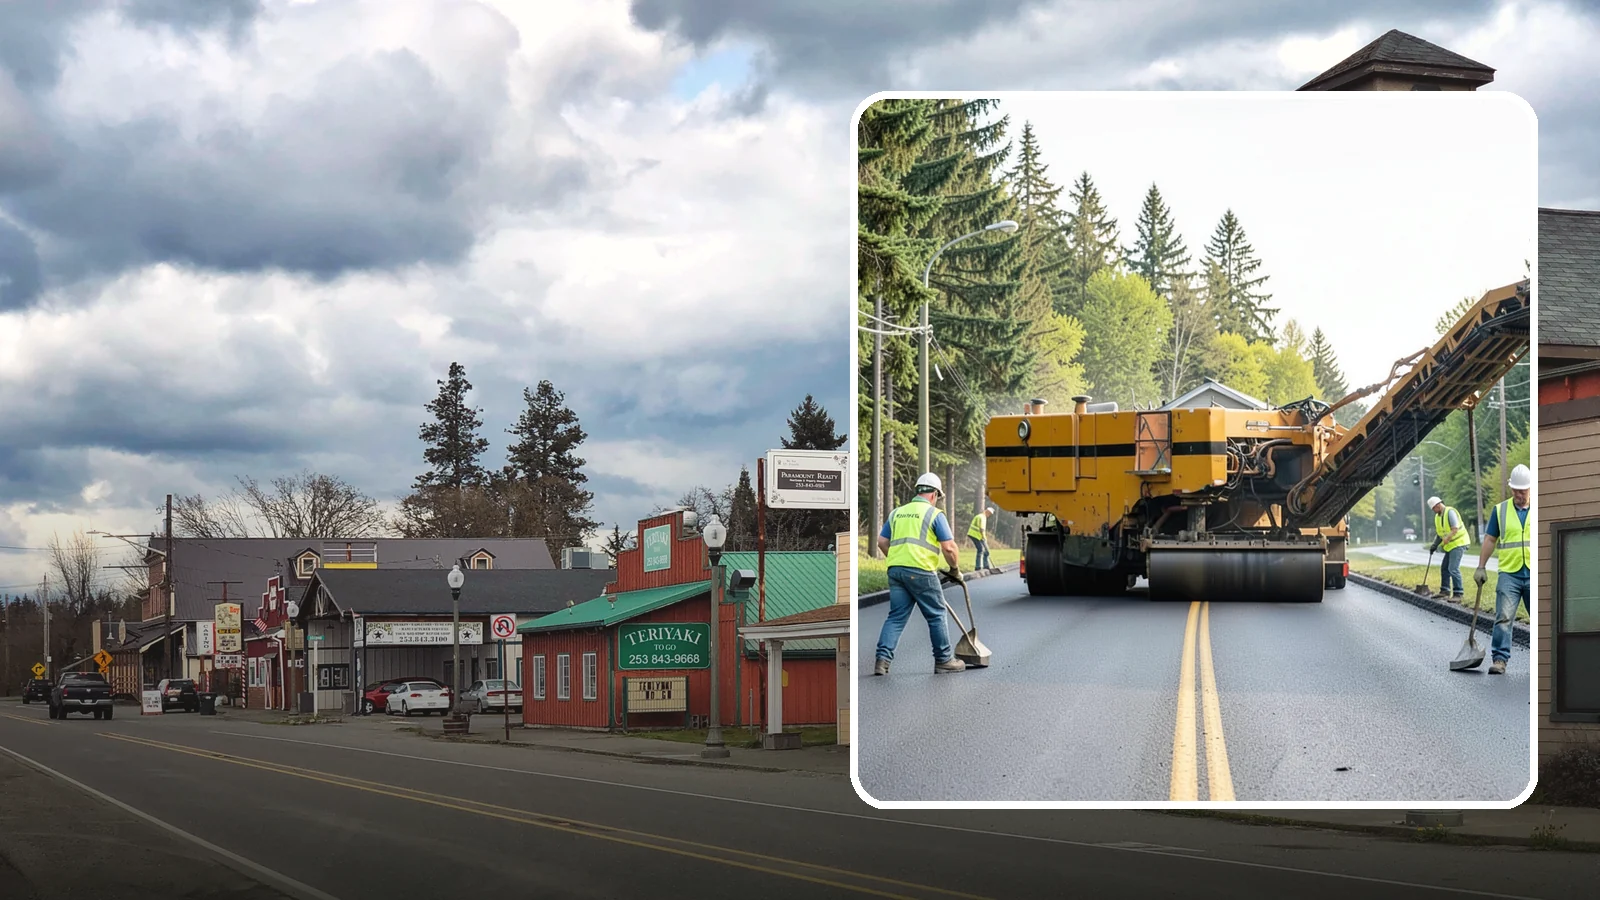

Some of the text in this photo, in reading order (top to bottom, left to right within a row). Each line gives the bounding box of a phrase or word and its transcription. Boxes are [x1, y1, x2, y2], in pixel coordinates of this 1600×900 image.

[781, 471, 839, 480] PARAMOUNT REALTY
[624, 627, 702, 646] TERIYAKI
[628, 653, 700, 665] 253 843-9668
